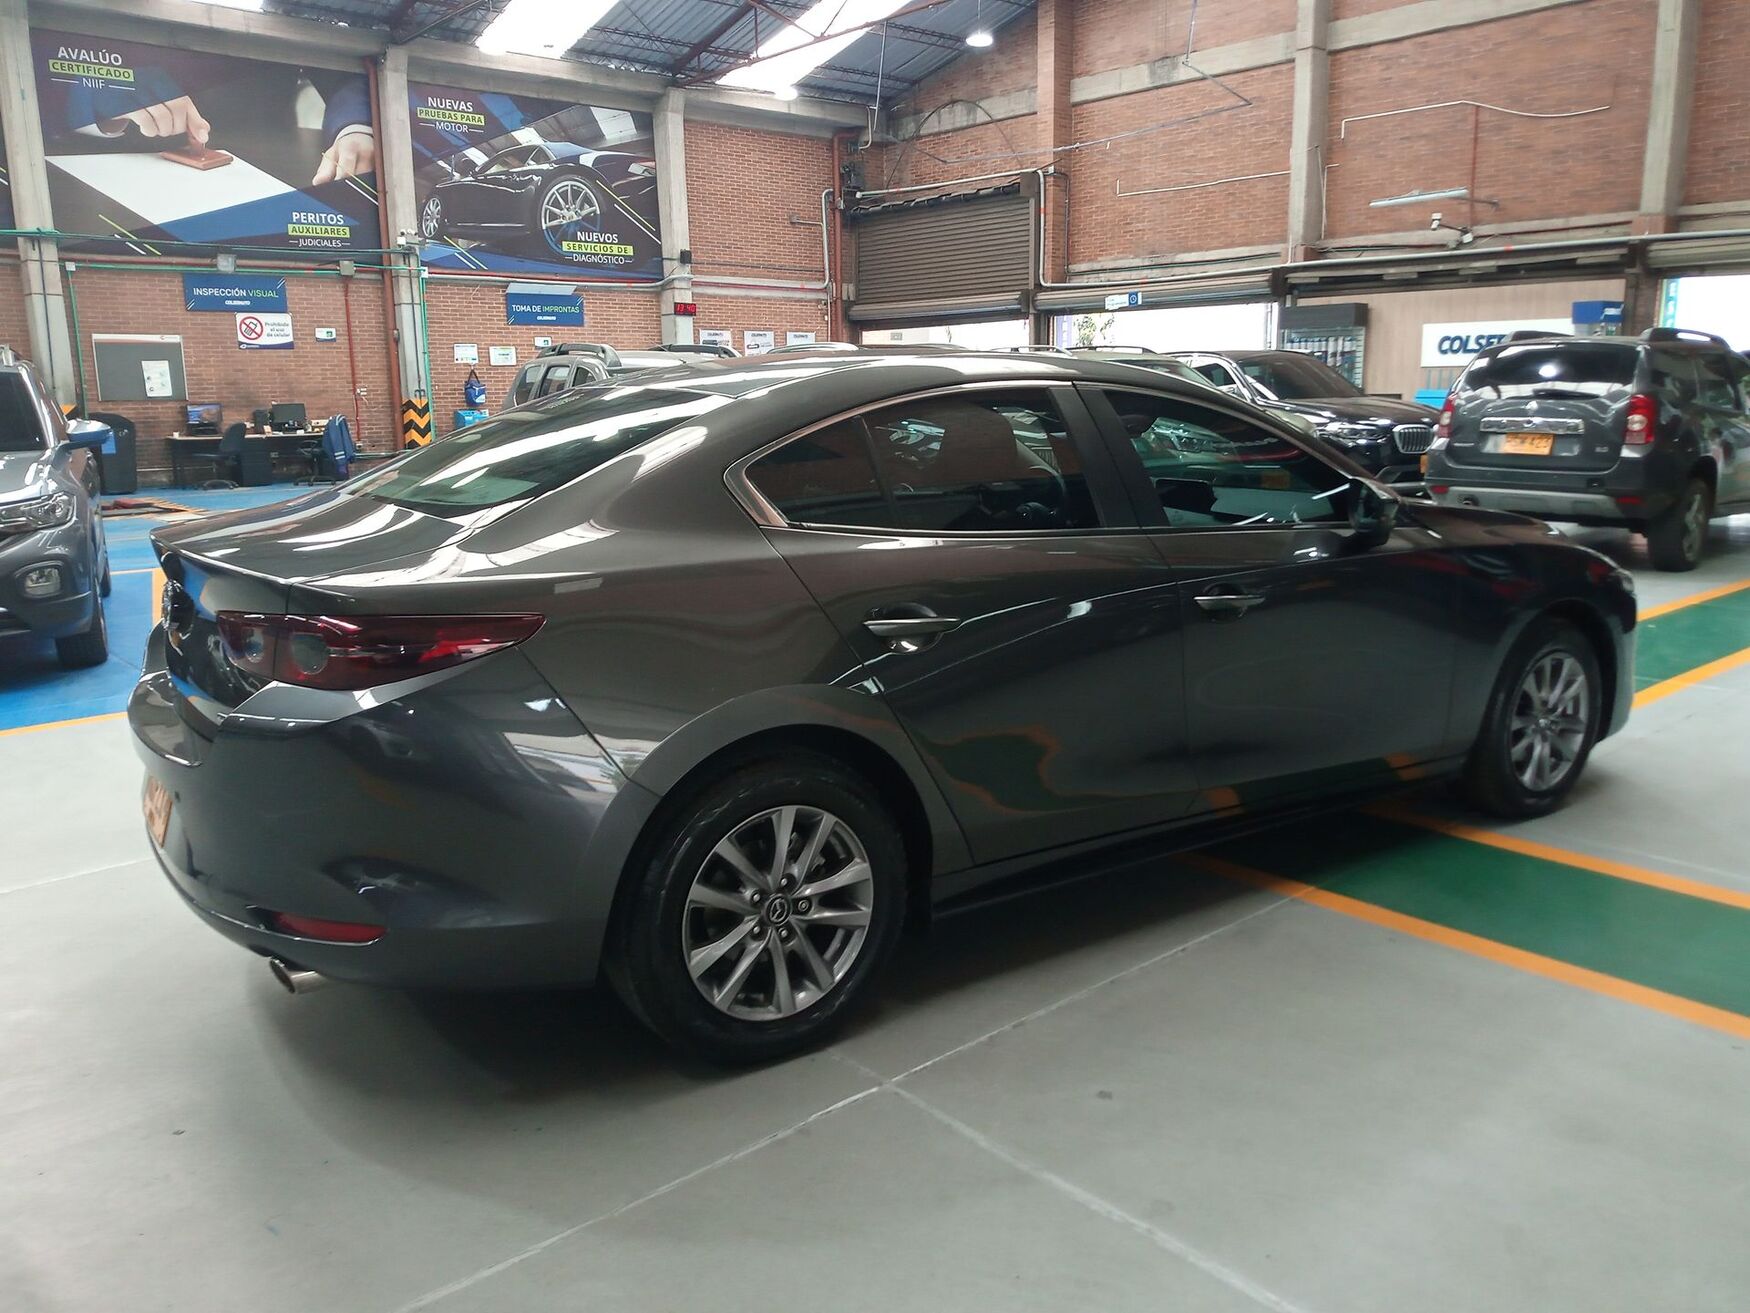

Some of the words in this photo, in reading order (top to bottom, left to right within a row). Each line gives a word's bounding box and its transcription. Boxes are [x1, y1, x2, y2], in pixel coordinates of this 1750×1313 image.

[58, 46, 122, 65] AVALÚO
[52, 61, 131, 79] CERTIFICADO
[82, 77, 106, 89] NIIF
[427, 96, 473, 112] NUEVAS
[418, 108, 459, 121] PRUEBAS
[460, 113, 483, 124] PARA
[435, 121, 469, 133] MOTOR
[292, 211, 344, 225] PERITOS
[291, 226, 347, 236] AUXILIARES
[577, 231, 618, 243] NUEVOS
[299, 238, 342, 247] JUDICIALES
[566, 243, 614, 253] SERVICIOS
[573, 253, 624, 264] DIAGNÓSTICO
[193, 287, 247, 297] INSPECCIÓN
[247, 289, 279, 298] VISUAL
[511, 304, 532, 312] TOMA
[532, 305, 541, 313] DE
